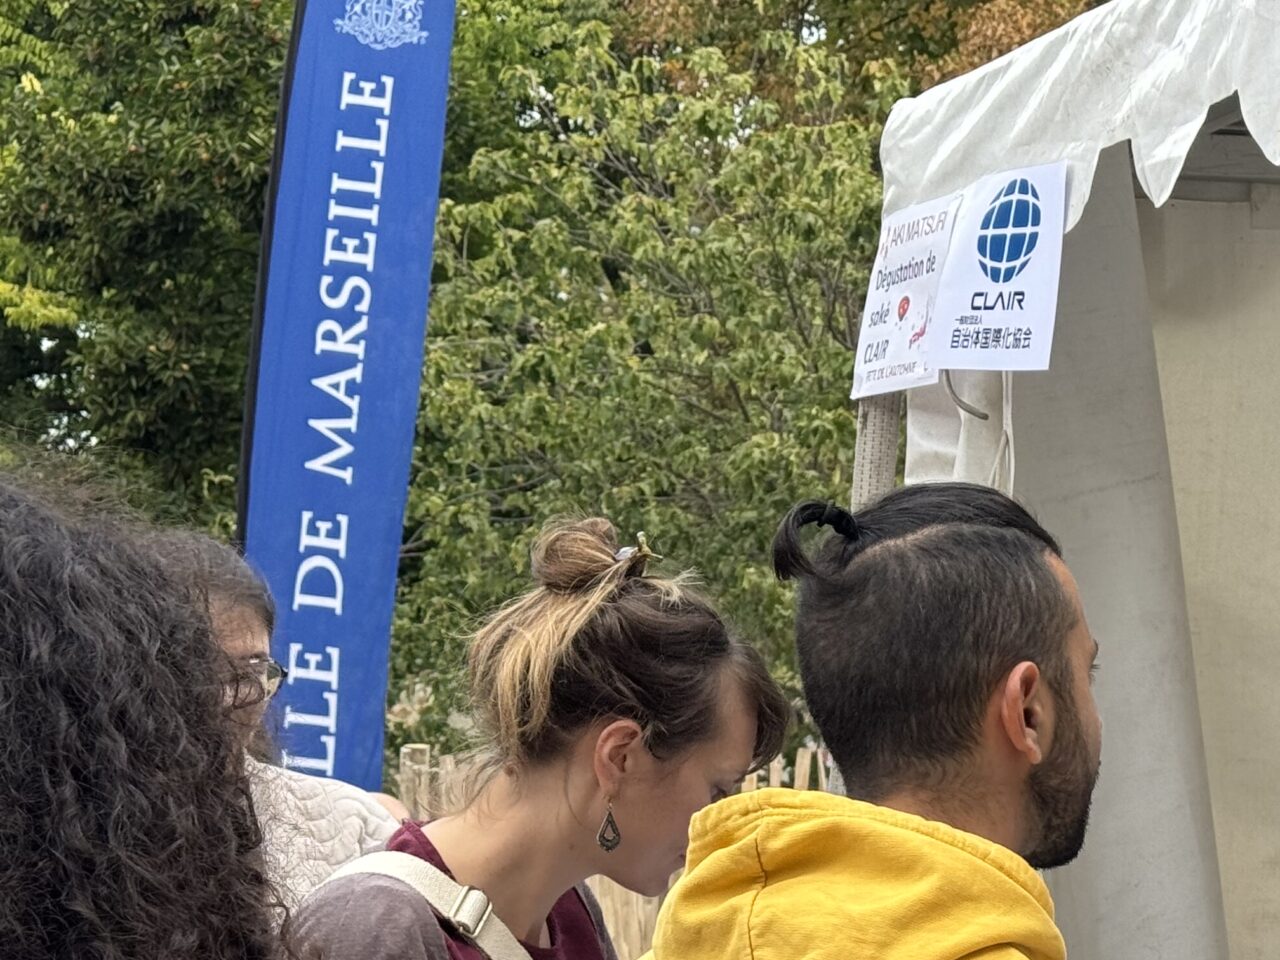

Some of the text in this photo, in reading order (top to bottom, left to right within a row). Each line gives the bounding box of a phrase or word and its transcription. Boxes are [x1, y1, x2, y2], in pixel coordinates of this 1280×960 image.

[304, 71, 395, 486] MARSEILLE
[876, 249, 936, 292] Dégustation de
[971, 291, 1025, 310] CLAIR
[868, 301, 891, 328] saké
[864, 339, 889, 364] CLAIR
[950, 327, 1032, 349] 自治体国際化協会
[292, 511, 349, 616] DE
